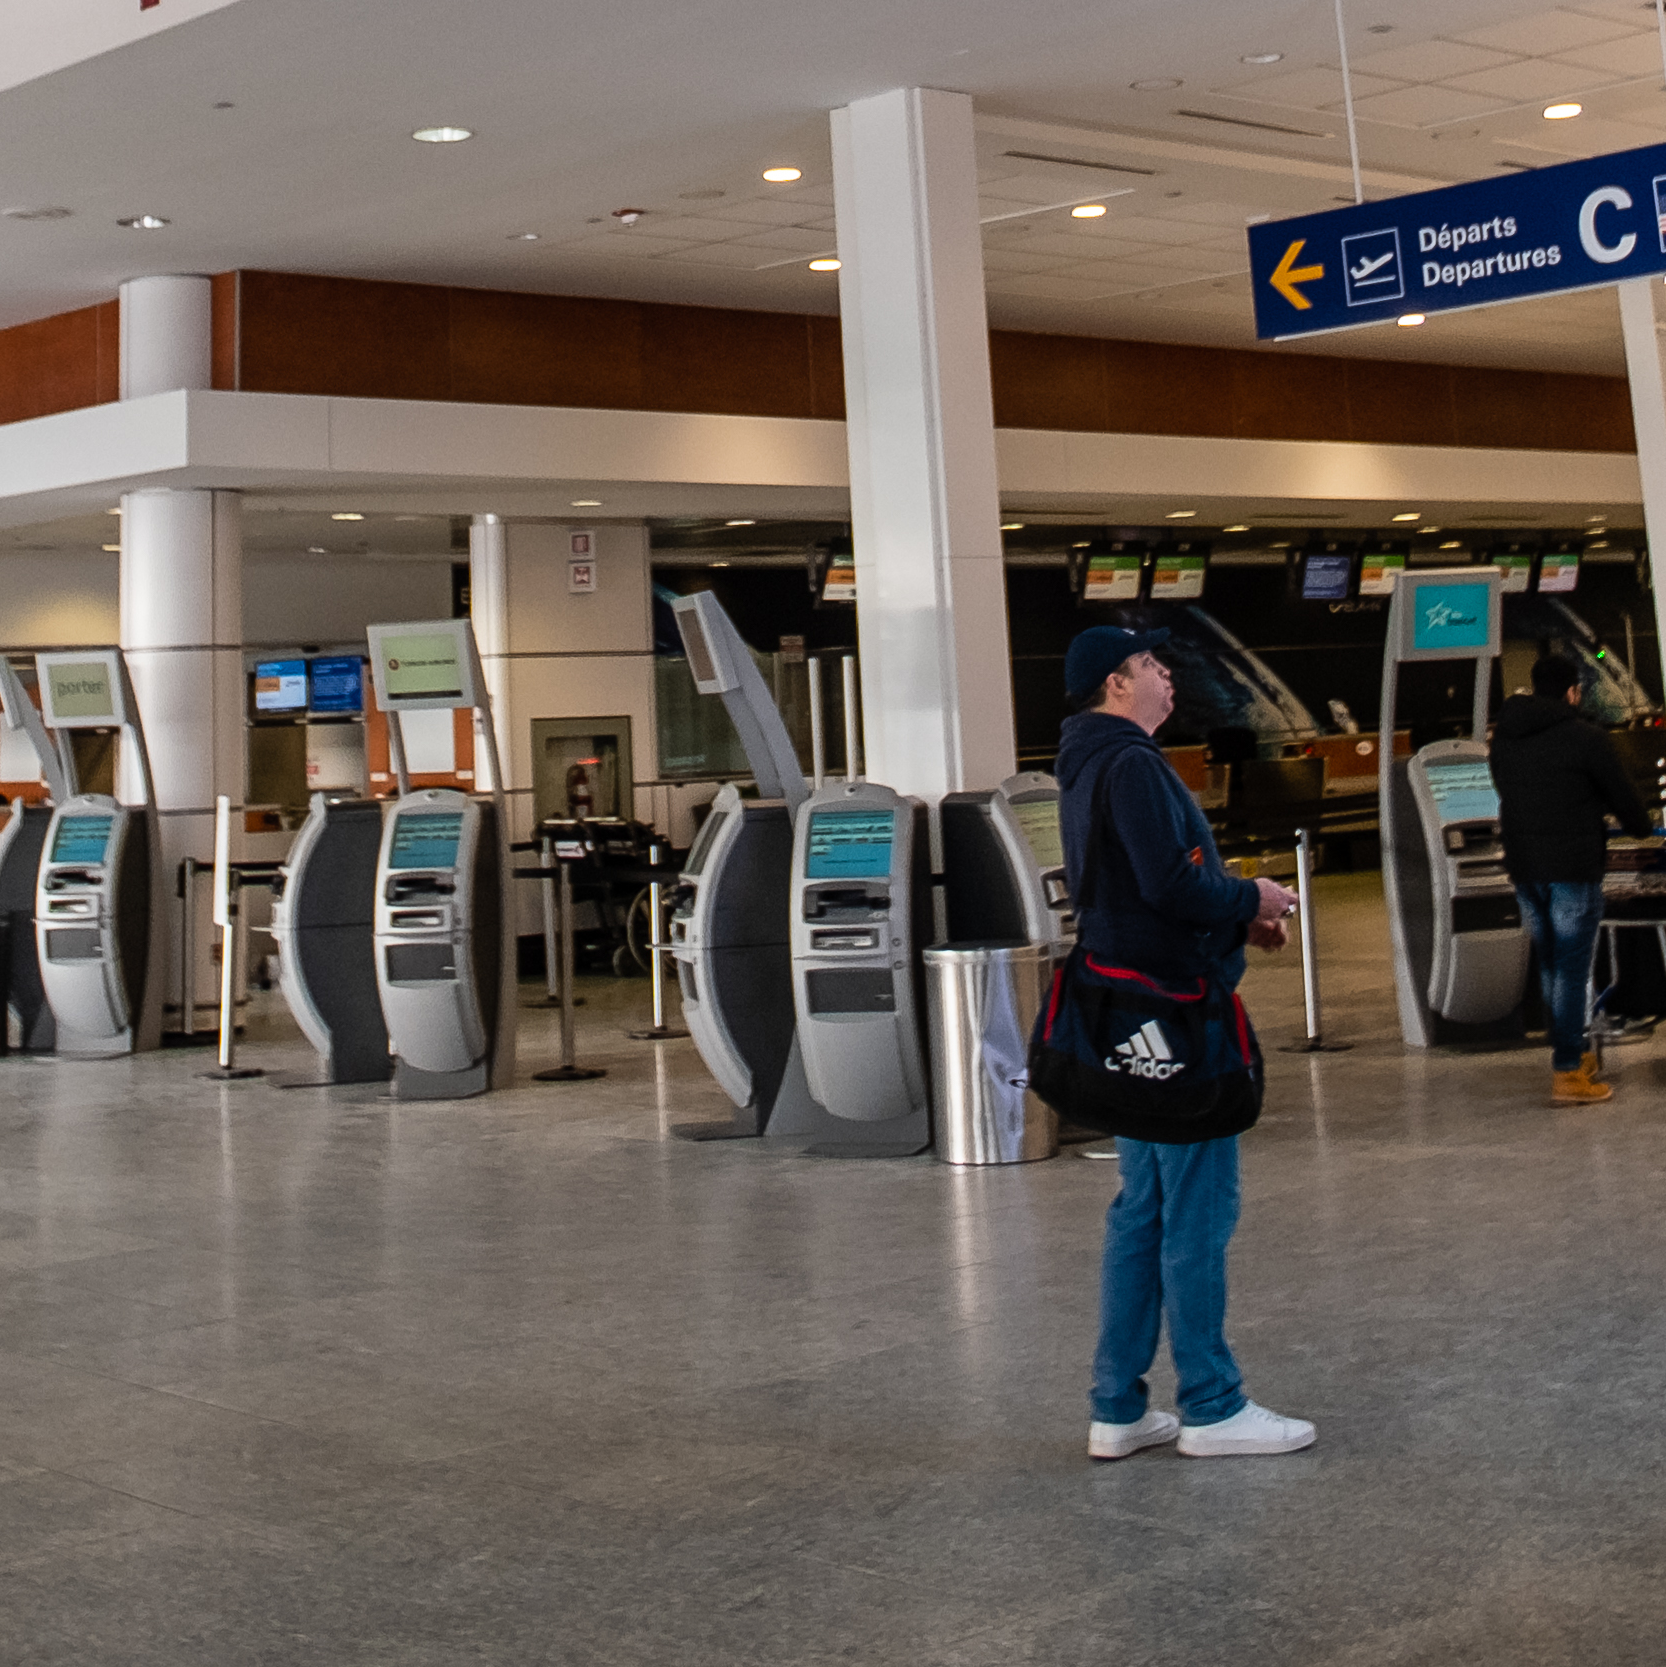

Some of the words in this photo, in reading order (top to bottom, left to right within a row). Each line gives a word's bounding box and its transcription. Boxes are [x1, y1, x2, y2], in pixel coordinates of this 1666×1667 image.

[1418, 216, 1517, 253] Départs
[1578, 186, 1637, 264] C
[1422, 244, 1562, 288] Departures
